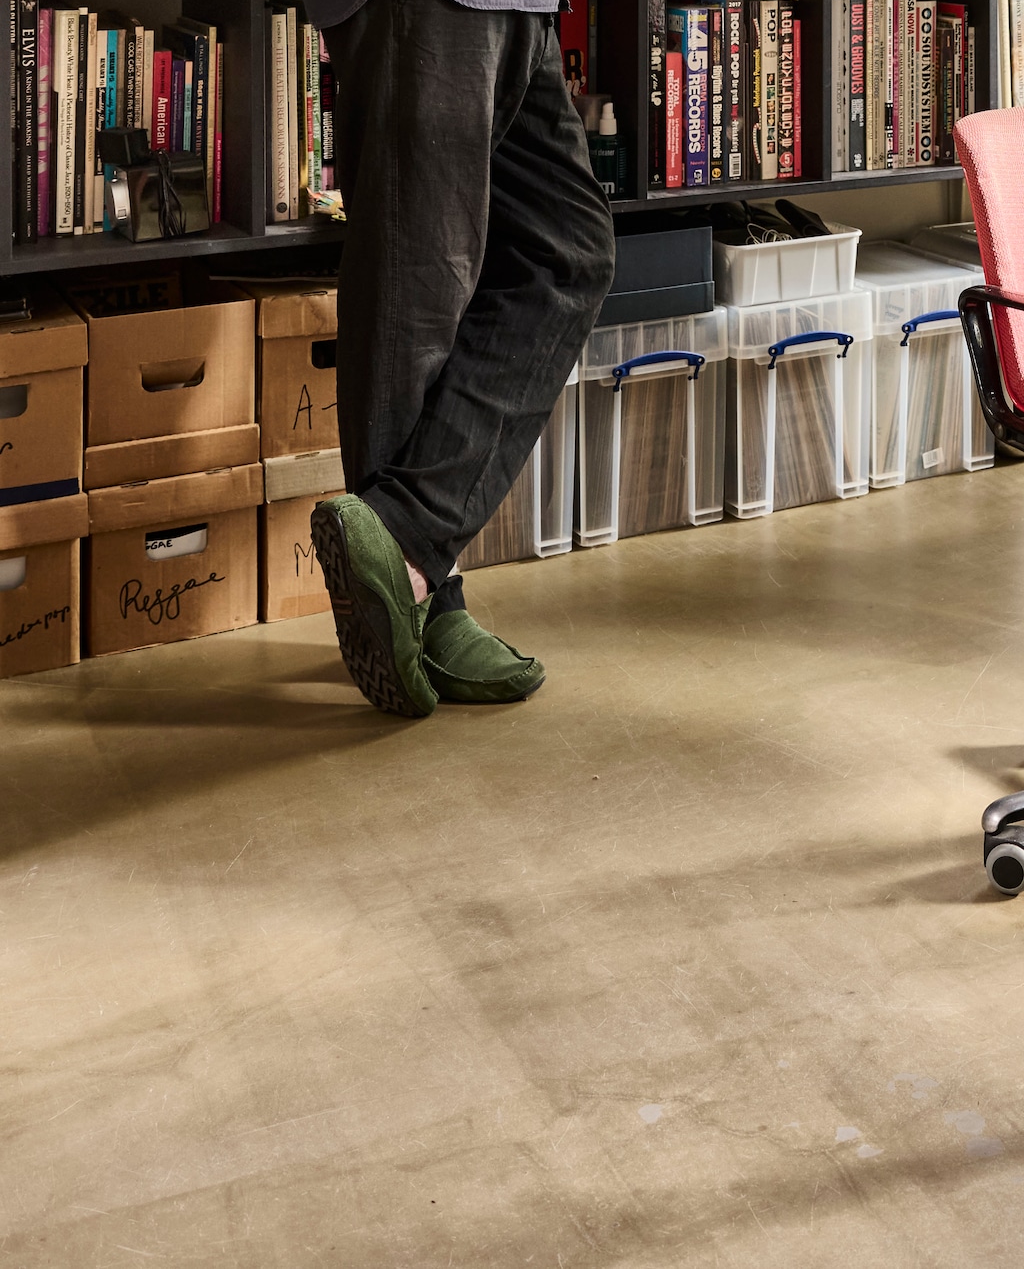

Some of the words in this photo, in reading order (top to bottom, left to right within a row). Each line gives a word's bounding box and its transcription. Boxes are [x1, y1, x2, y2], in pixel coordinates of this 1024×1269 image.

[66, 17, 75, 34] Black
[852, 4, 864, 31] DUST
[21, 28, 35, 67] ELVIS
[688, 28, 707, 71] 45
[730, 13, 740, 79] ROCK&POP
[852, 35, 864, 44] &
[651, 47, 662, 71] ART
[851, 46, 864, 94] GROOVES
[196, 80, 204, 97] ROCK
[711, 65, 722, 94] Rhythm
[921, 36, 931, 134] SOUNDSYSTEM
[25, 95, 32, 103] IN
[688, 74, 700, 154] RECORDS
[713, 95, 722, 103] &
[156, 97, 168, 144] American
[713, 104, 722, 125] Blues
[64, 123, 73, 143] History
[276, 107, 284, 161] RECORDING
[323, 111, 333, 159] UNDERGROUND
[712, 126, 722, 158] Records
[784, 154, 790, 164] 5
[119, 571, 226, 626] Reggae
